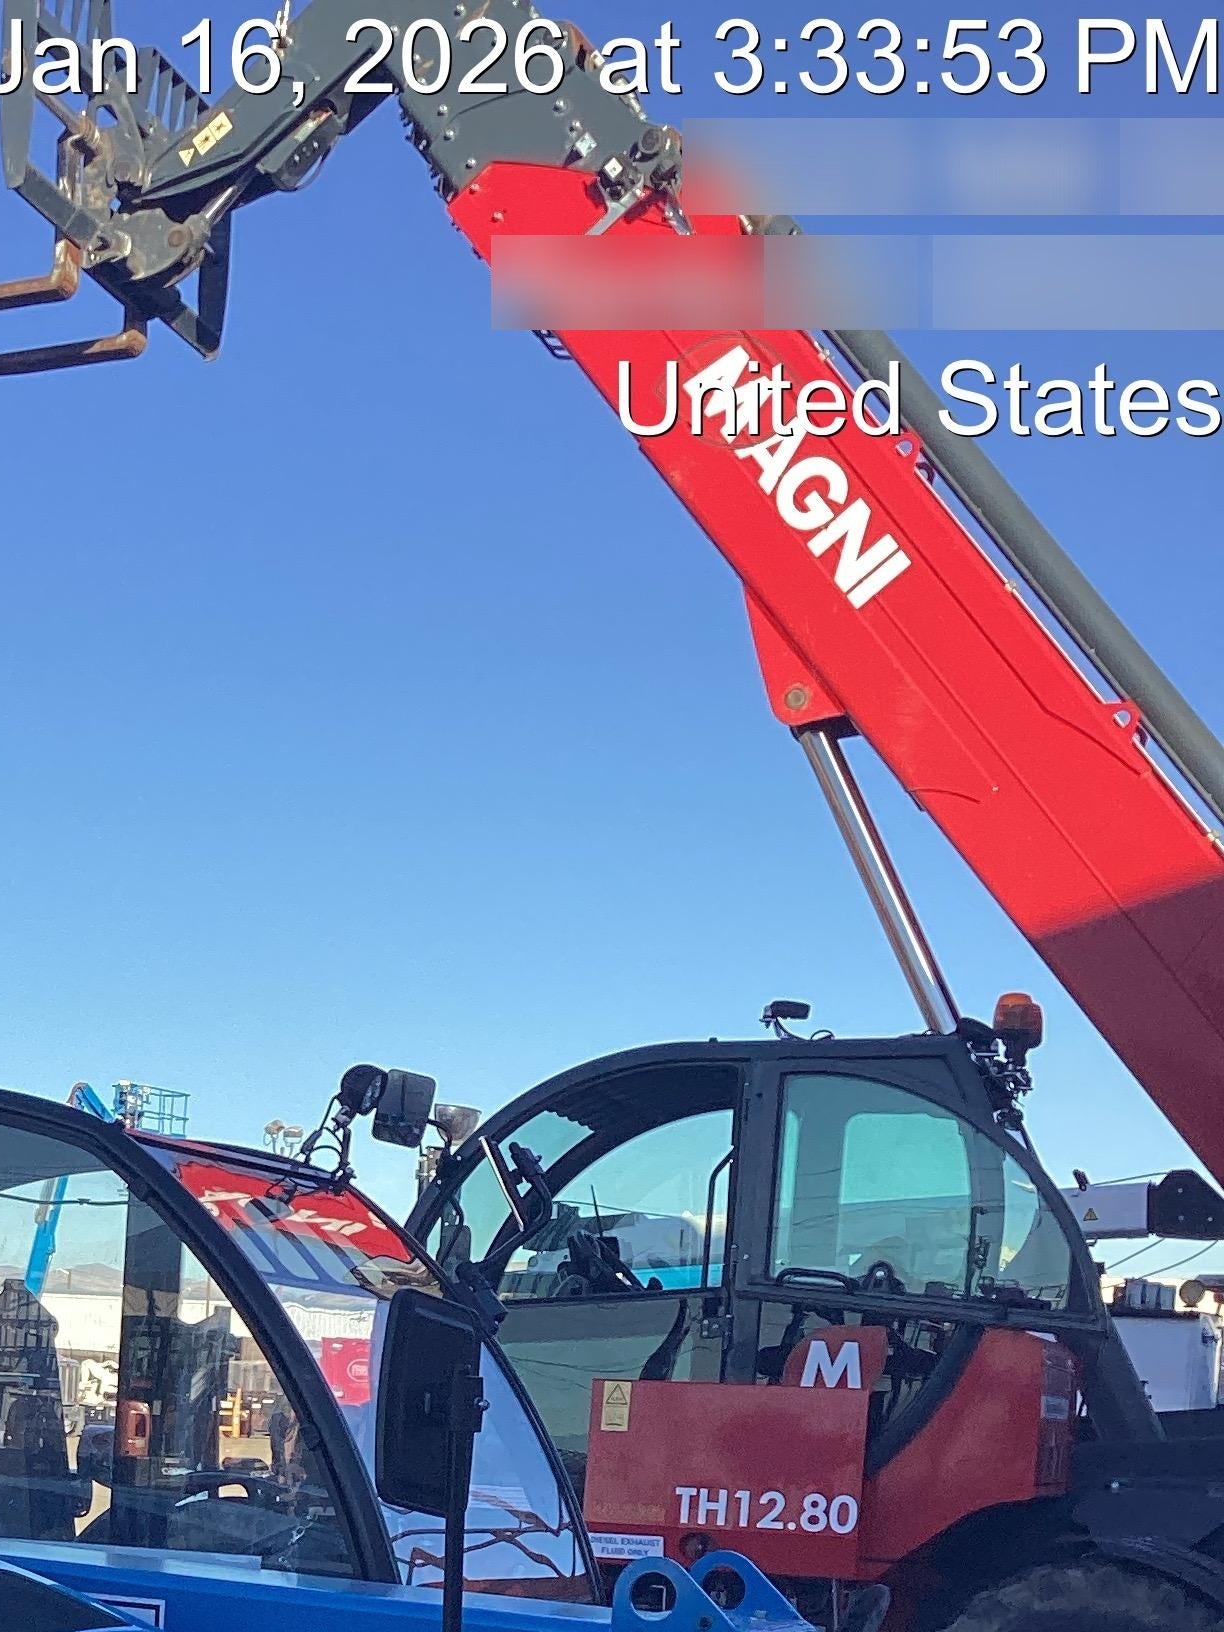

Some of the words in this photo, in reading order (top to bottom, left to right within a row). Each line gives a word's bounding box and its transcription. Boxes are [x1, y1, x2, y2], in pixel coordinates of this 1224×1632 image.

[682, 344, 913, 611] MAGNI
[799, 1340, 862, 1390] M
[675, 1486, 859, 1534] TH12.80
